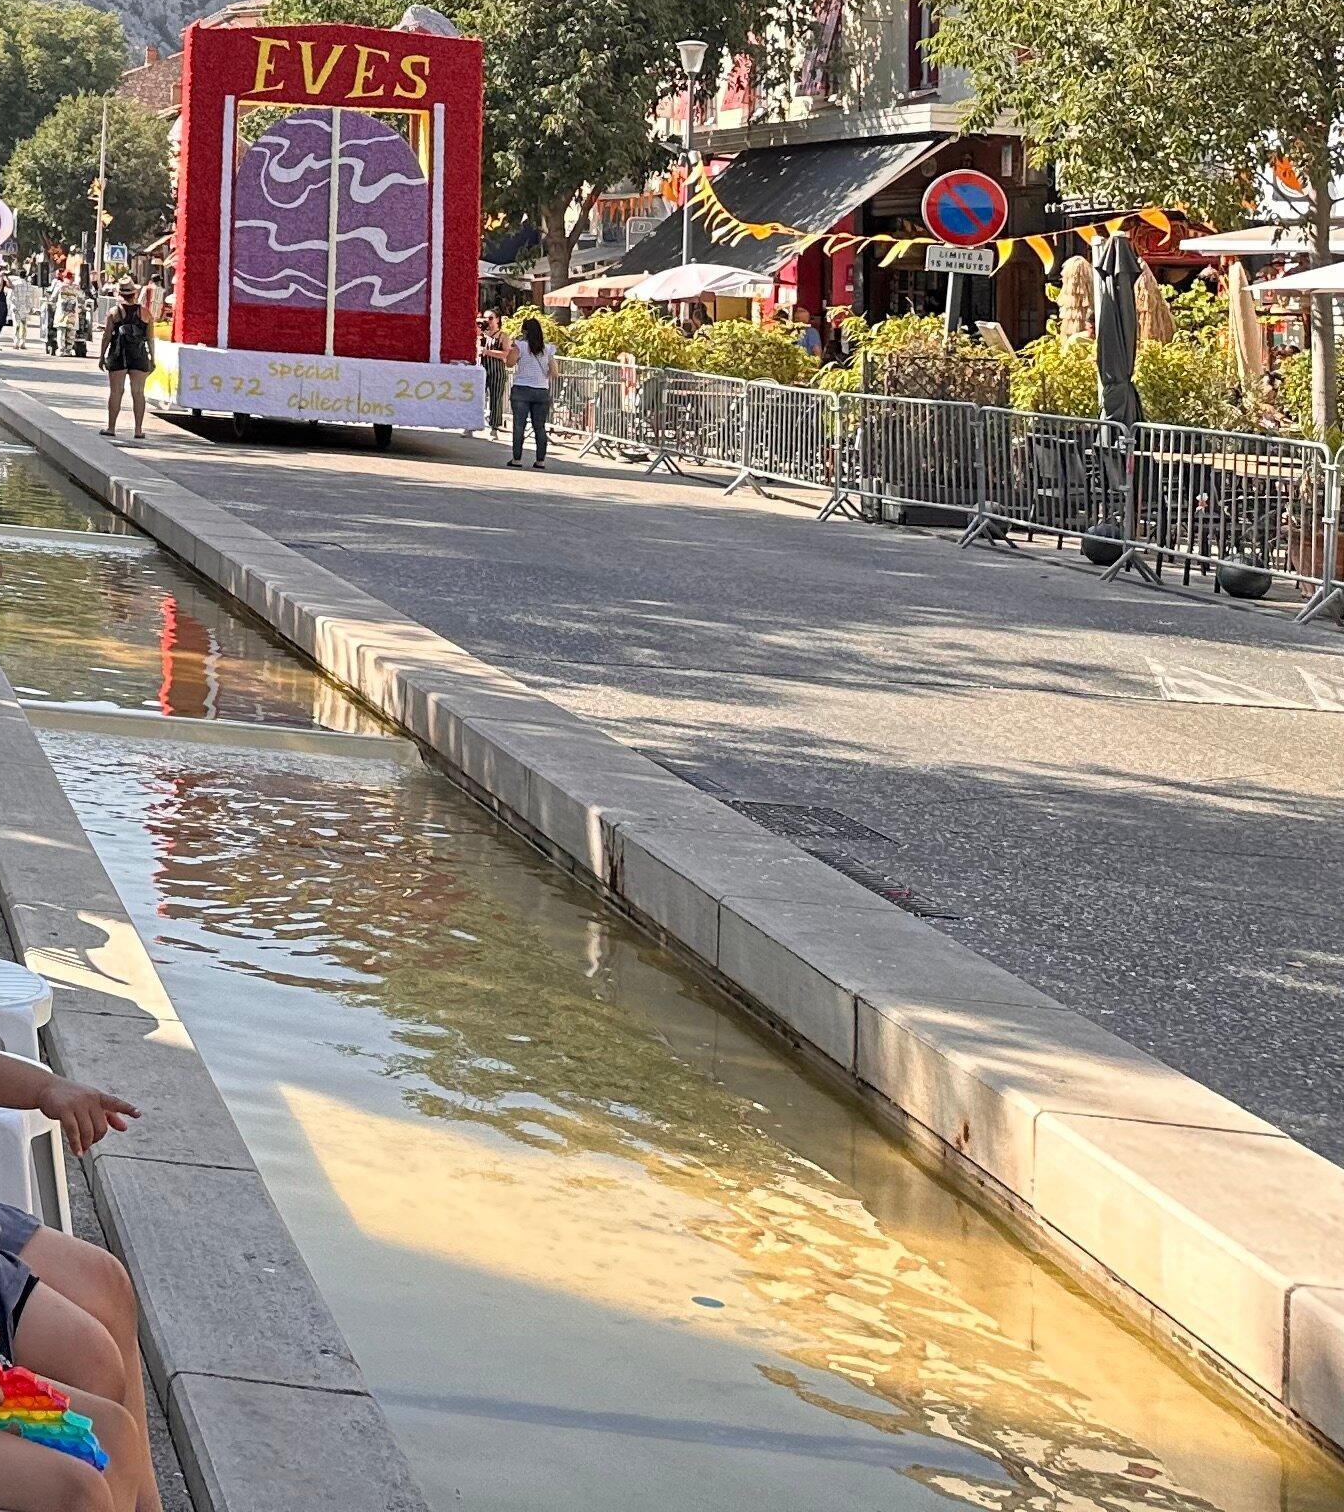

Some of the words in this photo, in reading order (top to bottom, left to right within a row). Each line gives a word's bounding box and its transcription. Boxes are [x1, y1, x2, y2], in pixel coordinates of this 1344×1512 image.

[240, 36, 430, 99] EVES
[930, 259, 941, 268] 15
[945, 261, 990, 272] MINUTES
[188, 372, 263, 397] 1972
[394, 379, 477, 403] 2023
